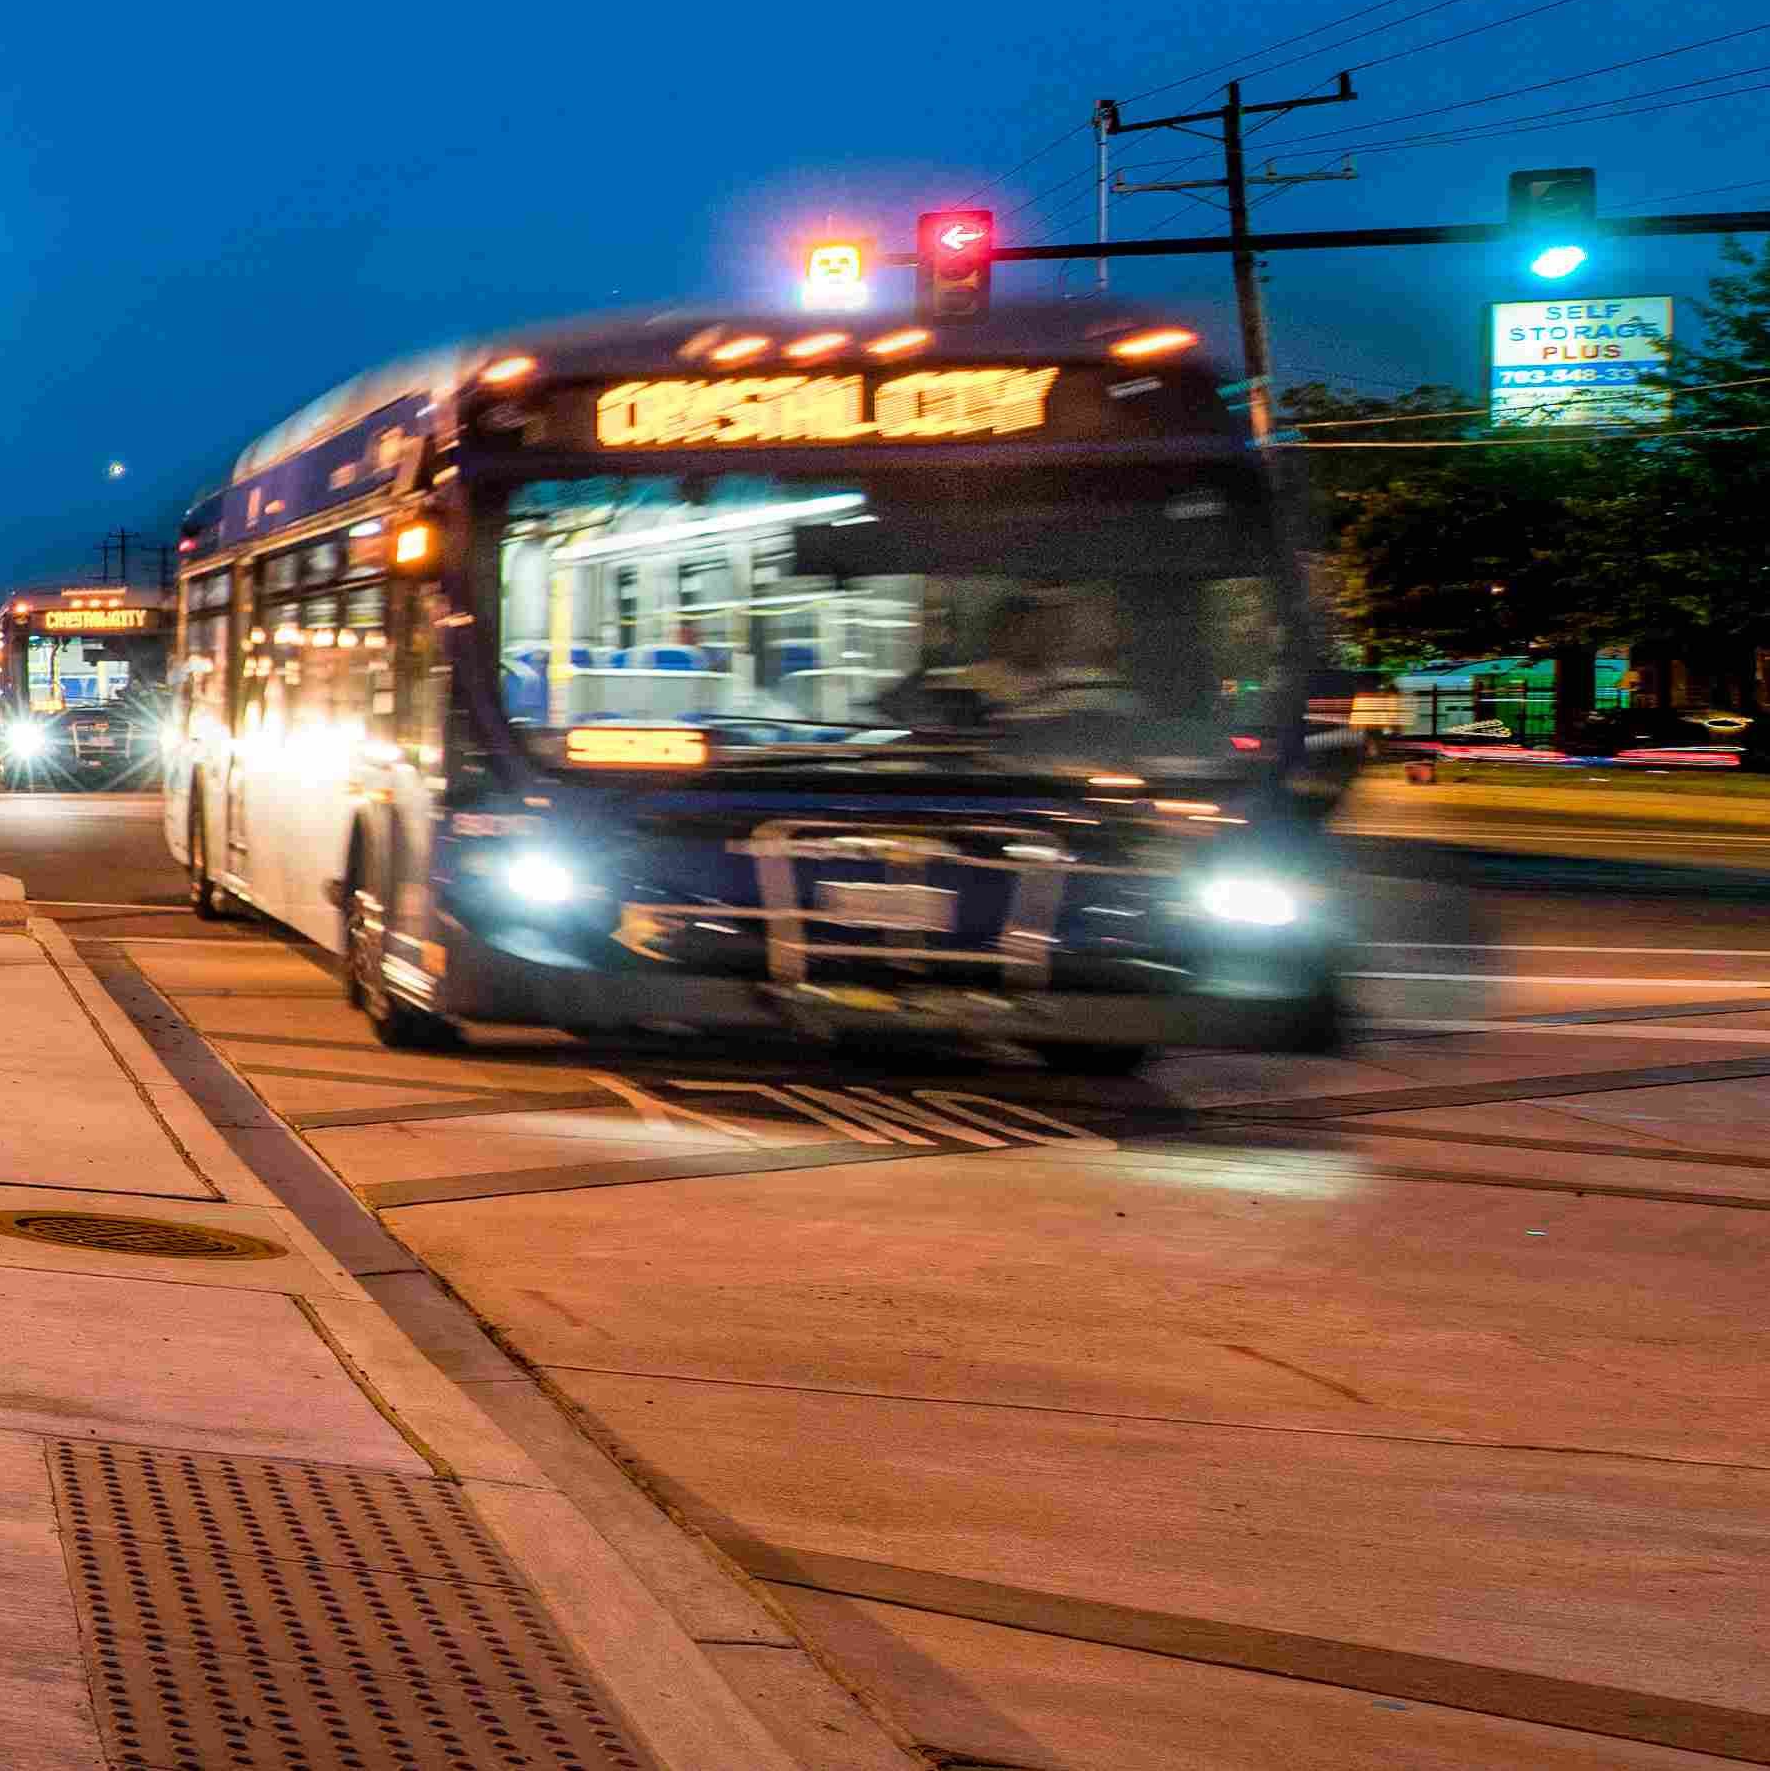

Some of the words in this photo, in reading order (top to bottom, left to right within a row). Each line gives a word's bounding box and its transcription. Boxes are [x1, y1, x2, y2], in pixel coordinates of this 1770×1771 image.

[1545, 303, 1622, 321] SELF
[1509, 321, 1660, 342] STORAGE
[1542, 343, 1623, 360] PLUS
